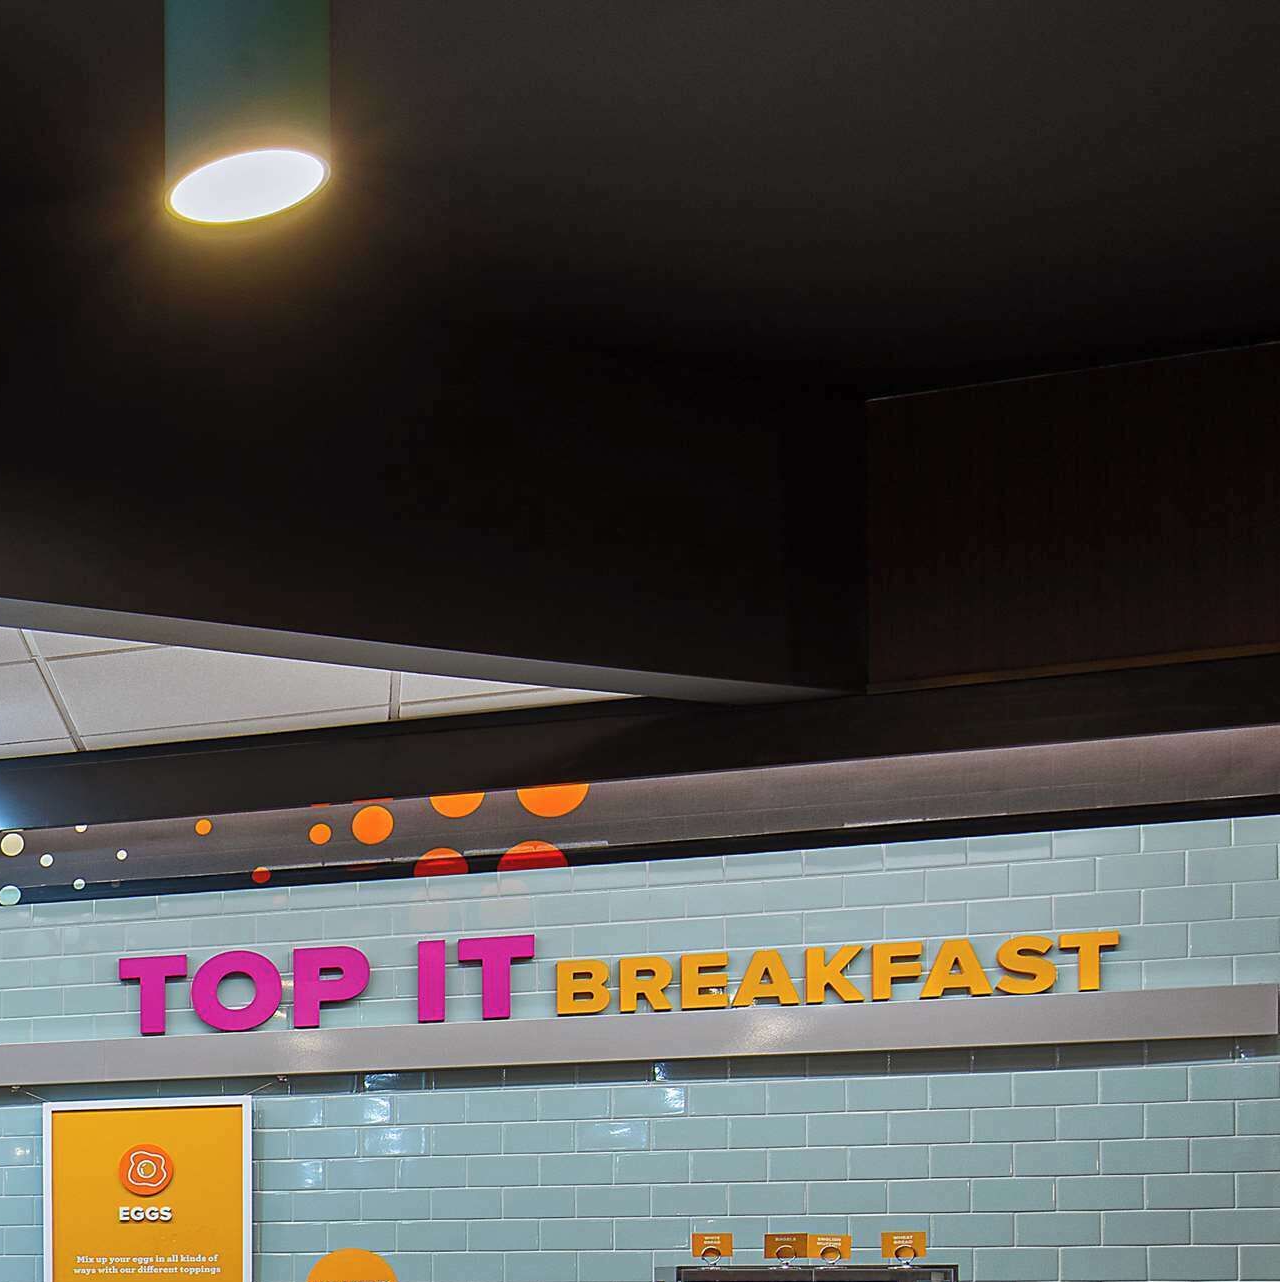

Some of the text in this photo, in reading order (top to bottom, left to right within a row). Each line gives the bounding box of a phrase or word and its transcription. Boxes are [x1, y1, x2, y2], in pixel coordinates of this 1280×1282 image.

[119, 931, 1120, 1036] TOP IT BREAKFAST
[119, 1206, 173, 1222] EGGS
[76, 1255, 95, 1263] Mix
[109, 1256, 131, 1264] your
[132, 1256, 154, 1264] eggs
[166, 1254, 178, 1262] all
[180, 1254, 206, 1262] kinds
[208, 1254, 219, 1262] of
[73, 1267, 97, 1275] ways
[137, 1265, 179, 1273] different
[180, 1265, 221, 1275] toppings
